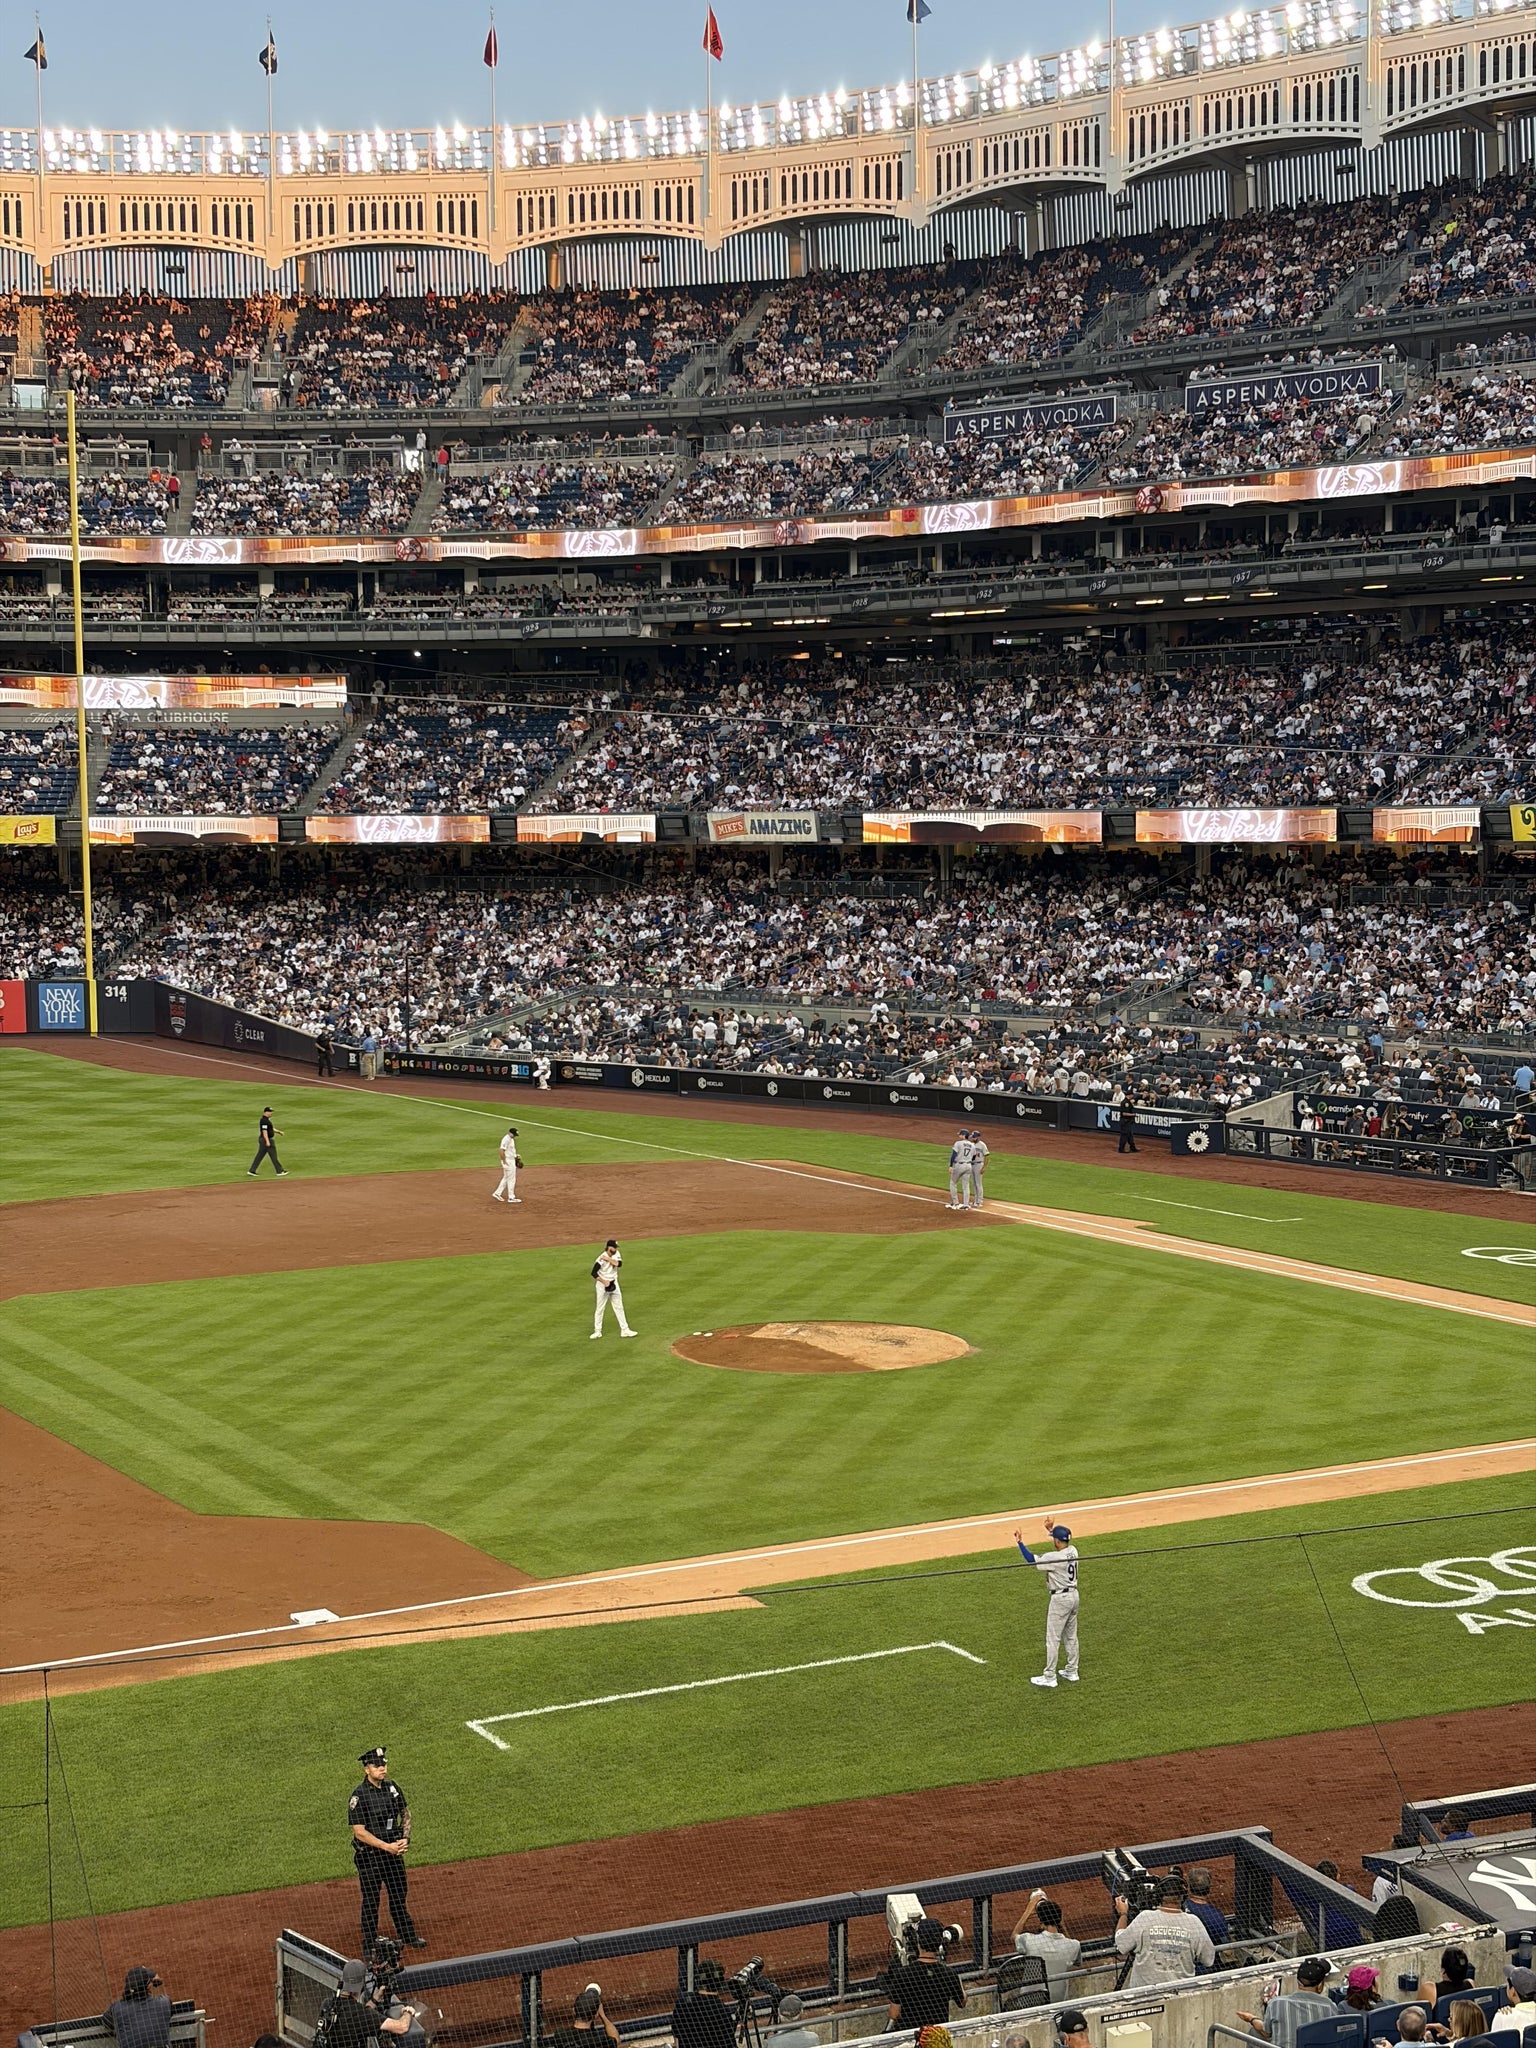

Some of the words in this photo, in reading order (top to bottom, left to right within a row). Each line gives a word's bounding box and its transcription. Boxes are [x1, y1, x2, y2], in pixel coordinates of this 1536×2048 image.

[1196, 384, 1266, 407] ASPEN
[1295, 372, 1368, 396] VODKA
[954, 414, 1016, 436] ASPEN
[1041, 404, 1105, 426] VODKA
[1422, 555, 1444, 568] 1938
[707, 605, 726, 615] 1927
[717, 820, 744, 835] MIKE'S
[749, 819, 812, 835] AMAZING
[46, 988, 77, 1001] NEW
[105, 985, 127, 998] 314
[41, 999, 81, 1012] YORK
[47, 1011, 77, 1023] LIFE
[245, 1028, 265, 1042] CLEAR
[645, 1074, 671, 1083] HEXCLAD
[833, 1089, 851, 1097] HEXCLAD
